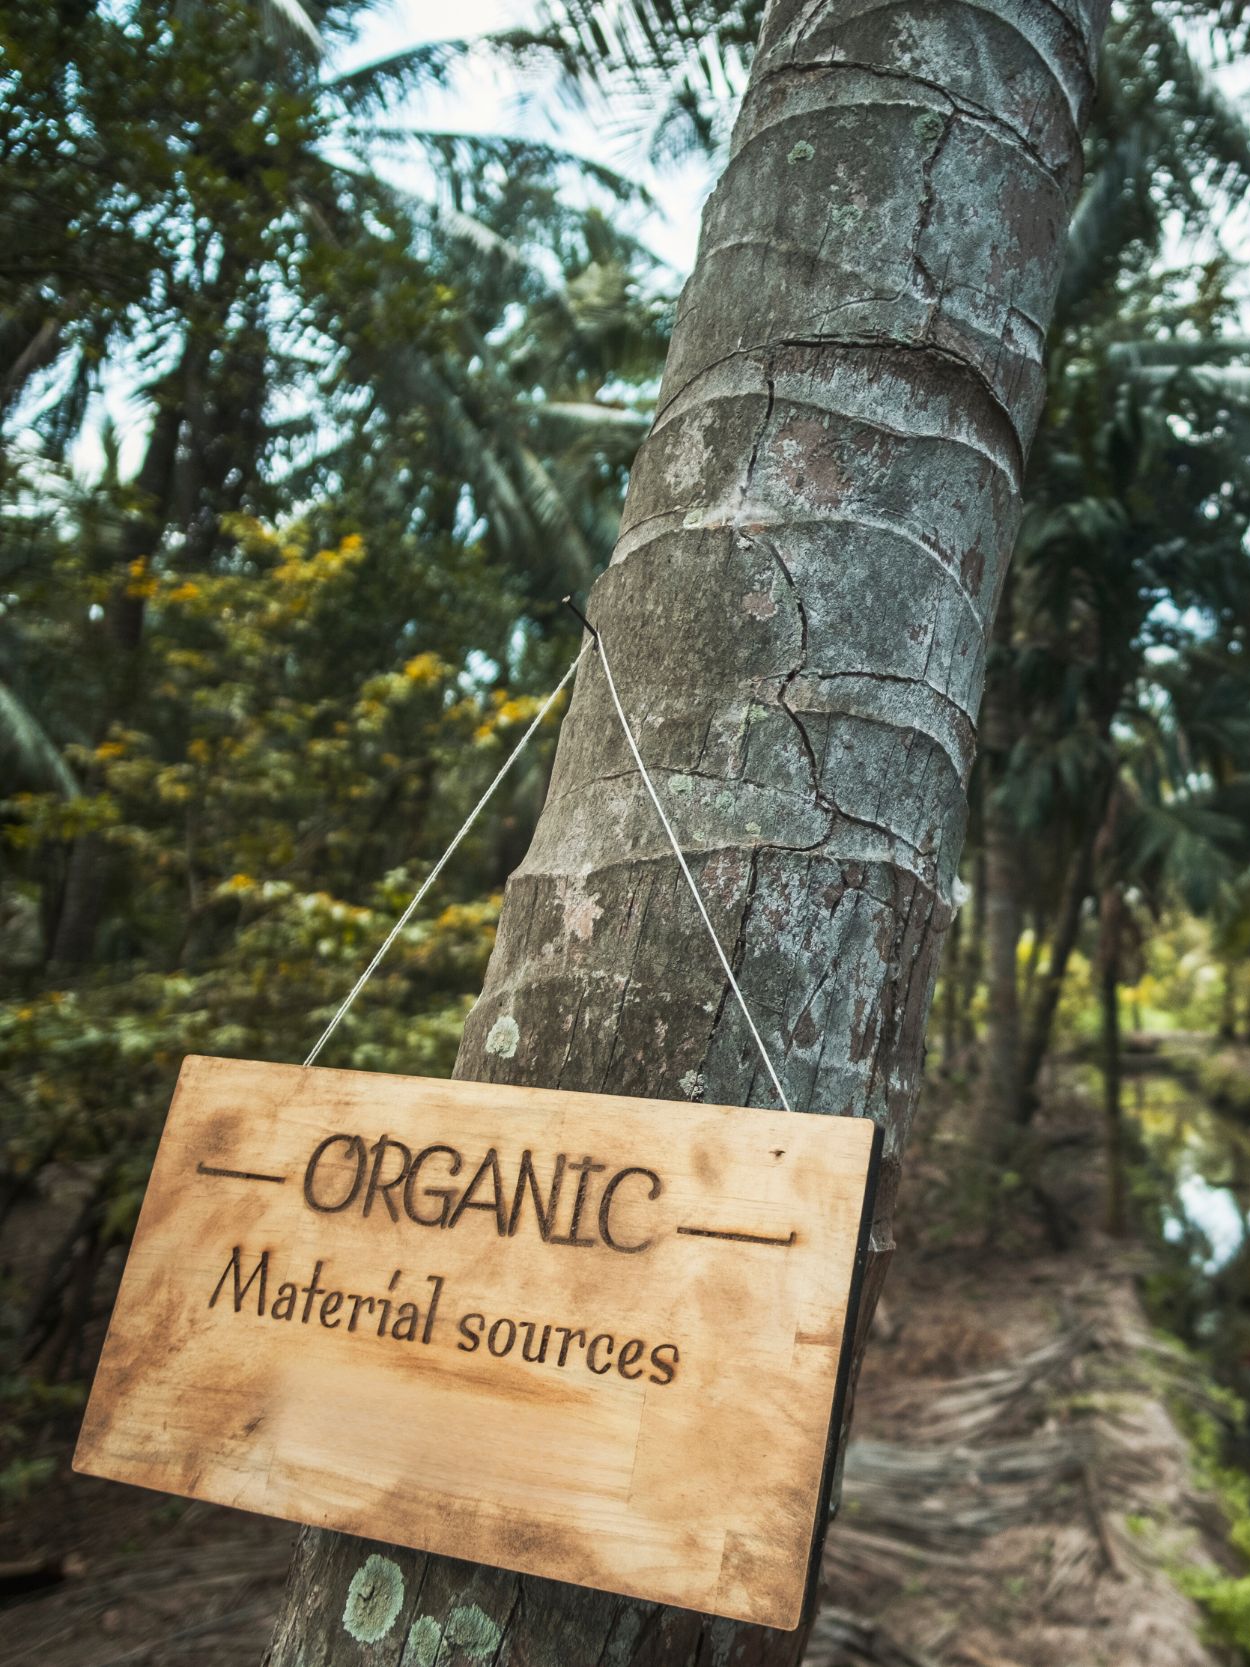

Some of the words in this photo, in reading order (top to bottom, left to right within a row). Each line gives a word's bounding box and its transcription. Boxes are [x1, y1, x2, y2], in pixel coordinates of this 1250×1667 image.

[304, 1133, 662, 1254] ORGANIC
[208, 1246, 445, 1345] Material
[457, 1312, 680, 1386] sources
